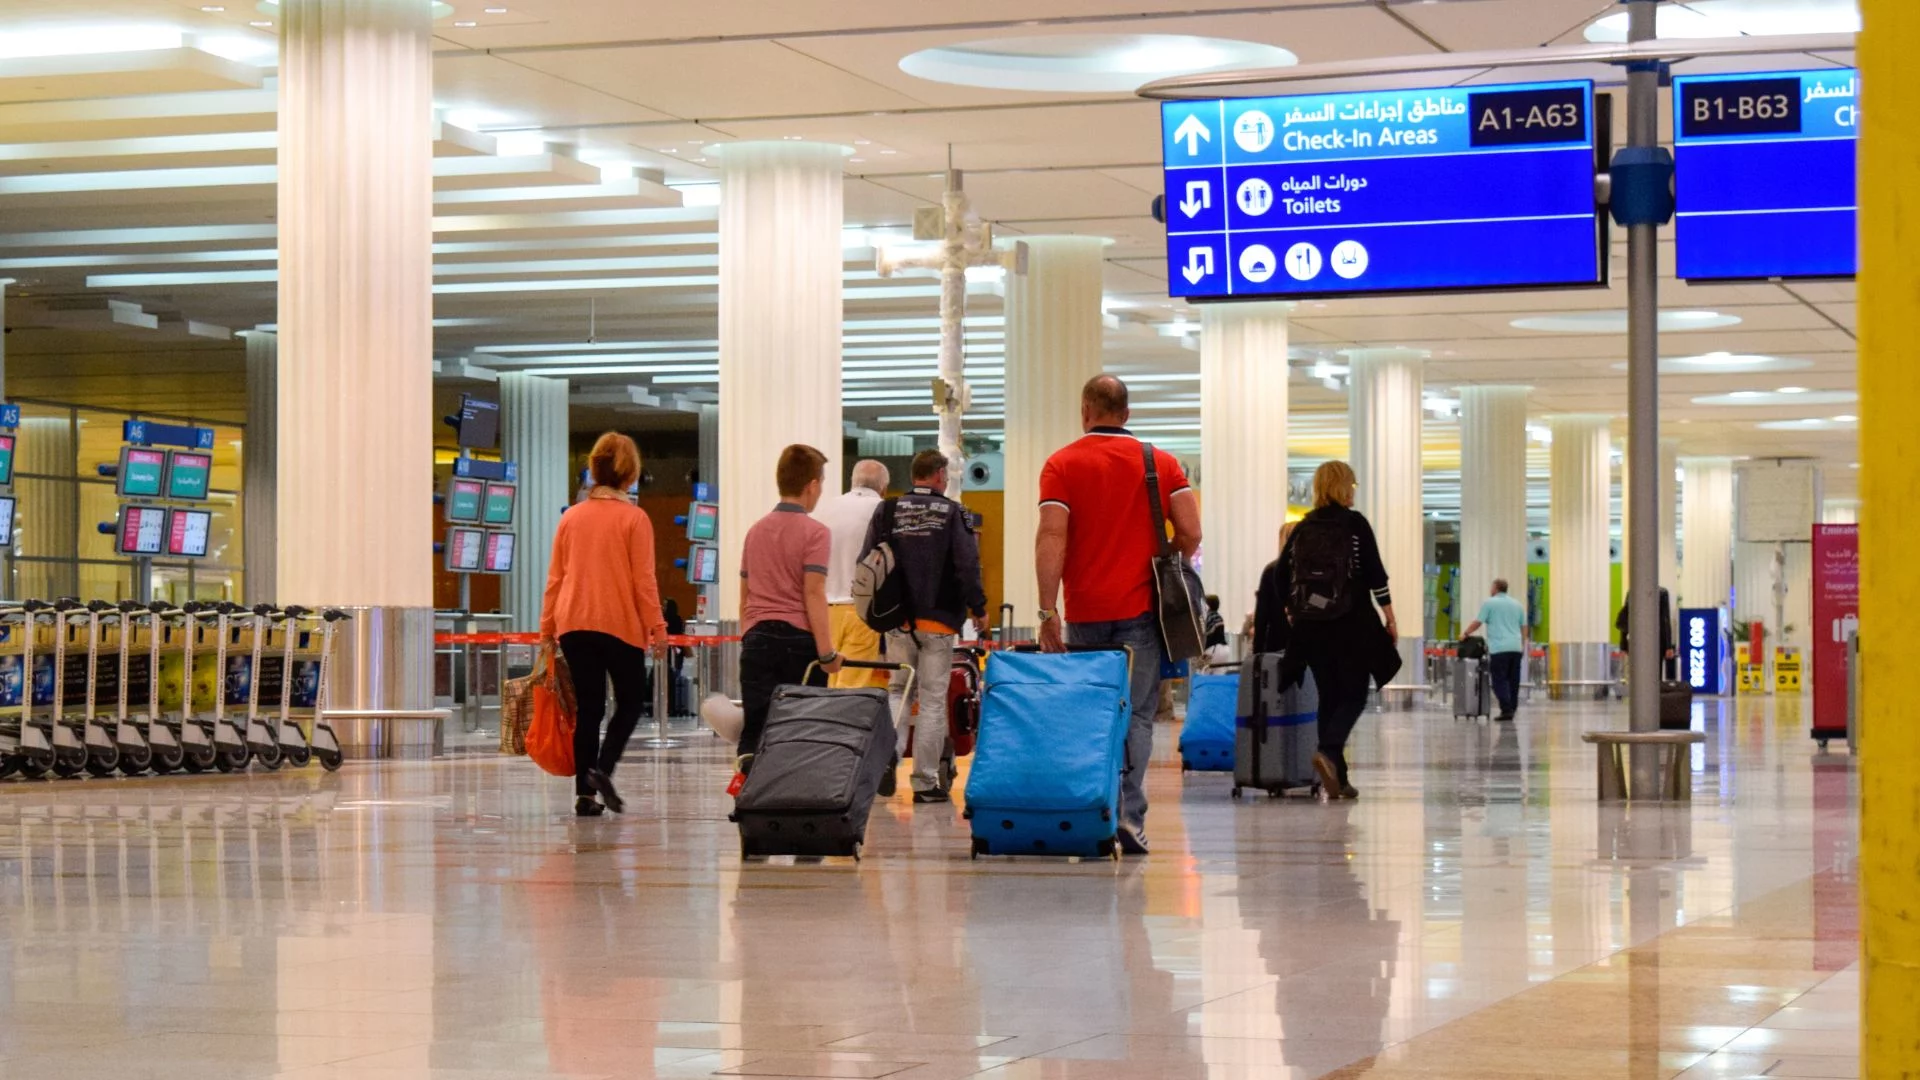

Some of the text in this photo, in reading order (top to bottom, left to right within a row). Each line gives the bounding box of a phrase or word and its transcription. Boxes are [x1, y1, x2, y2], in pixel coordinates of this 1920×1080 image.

[1283, 97, 1465, 128] مناطق إجراءات السفر
[1478, 103, 1578, 131] A1-A63
[1693, 95, 1789, 121] B1-B63
[1283, 126, 1438, 151] Check-In Areas
[1281, 173, 1368, 194] دورات المياه
[1283, 197, 1341, 214] Toilets
[4, 409, 17, 423] A5
[130, 425, 143, 439] A6
[200, 432, 212, 445] A7
